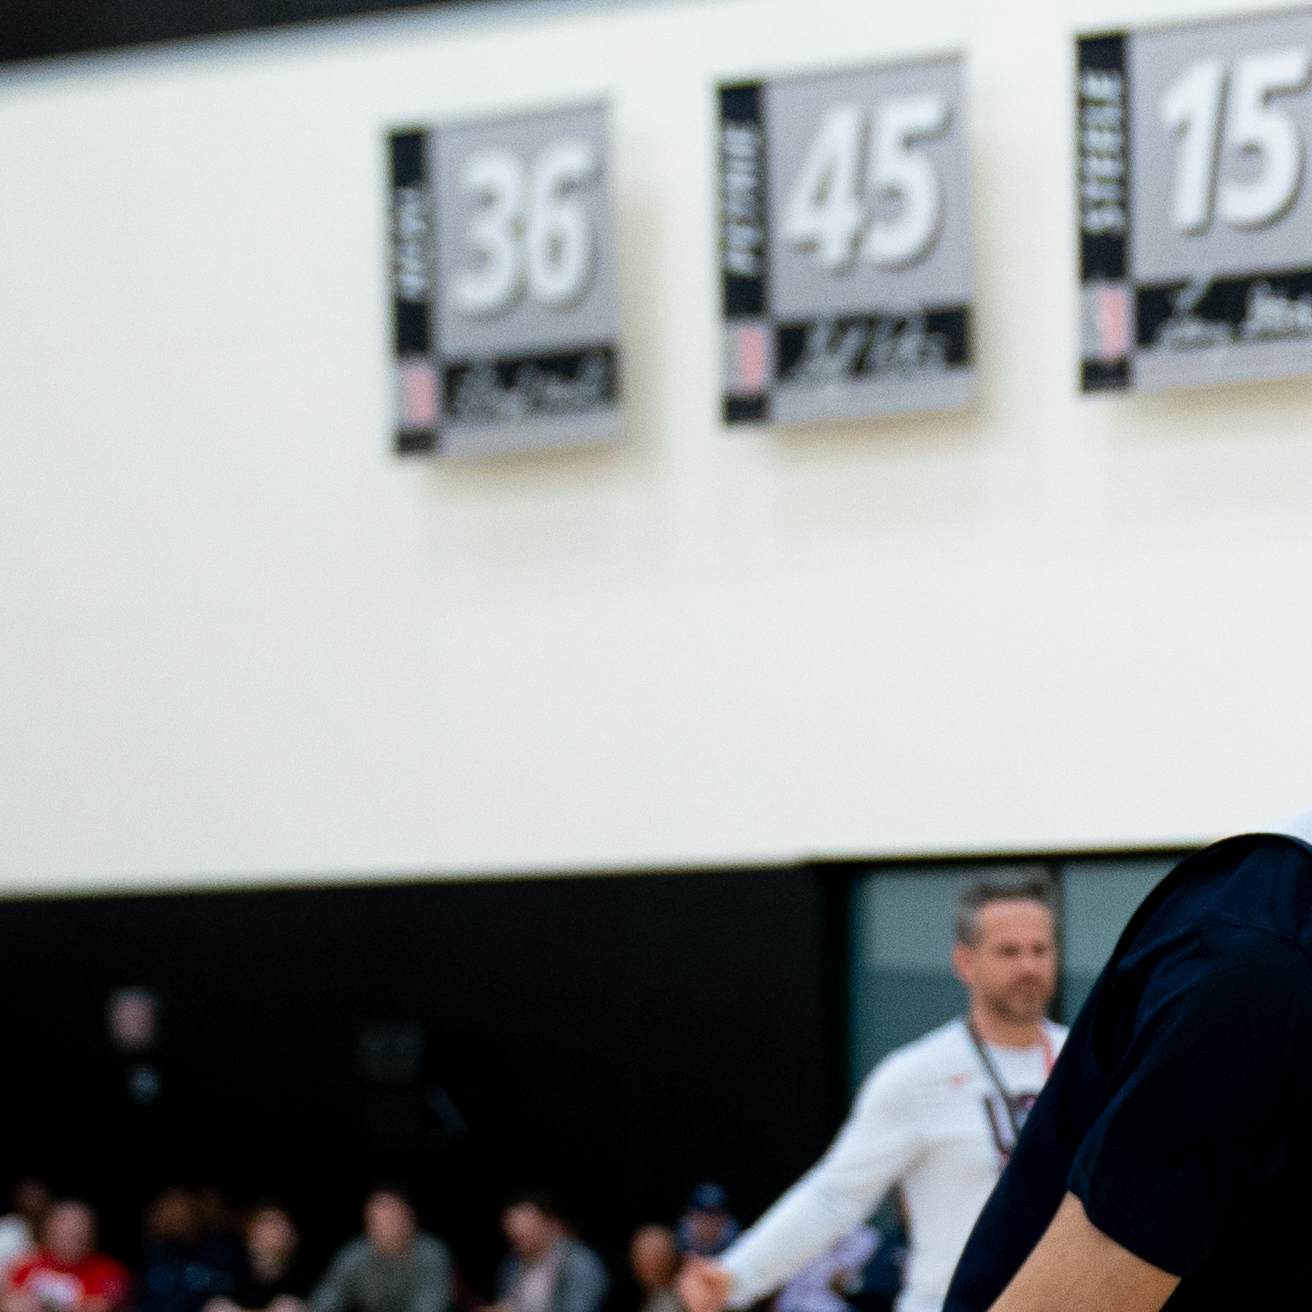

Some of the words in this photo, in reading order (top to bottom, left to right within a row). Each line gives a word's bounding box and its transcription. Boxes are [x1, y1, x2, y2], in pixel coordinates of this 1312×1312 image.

[454, 138, 595, 315] 36
[781, 92, 949, 270] 45
[1160, 49, 1312, 233] 15
